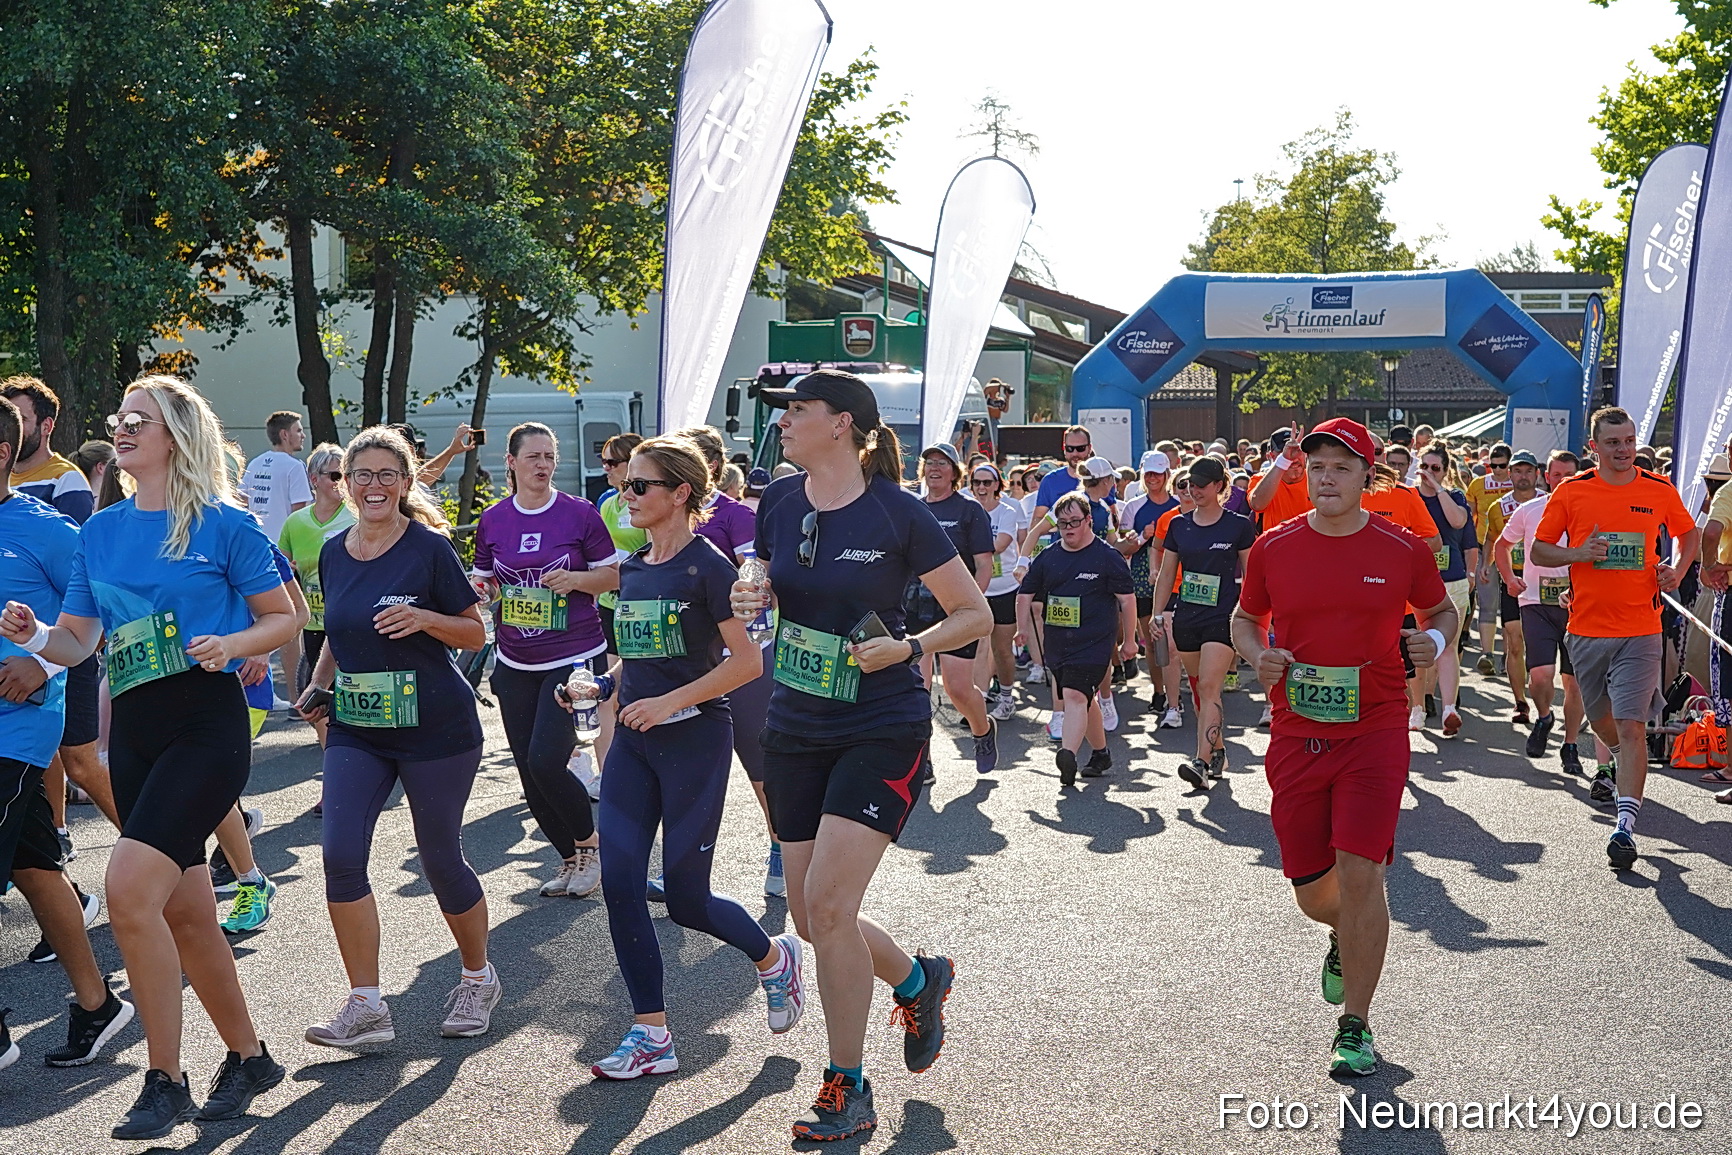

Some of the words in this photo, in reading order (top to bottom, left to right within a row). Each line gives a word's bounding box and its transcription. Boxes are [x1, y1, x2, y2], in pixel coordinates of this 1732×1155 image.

[1657, 170, 1702, 274] Fischer
[1320, 294, 1350, 302] Fischer
[1297, 309, 1386, 326] firmenlauf
[1126, 338, 1174, 350] Fischer
[1630, 506, 1653, 515] THULE
[1363, 576, 1385, 584] Florian
[1189, 583, 1209, 595] 916
[509, 599, 542, 615] 1554
[1052, 606, 1070, 617] 866
[619, 620, 652, 640] 1164
[652, 623, 662, 650] 2022
[634, 641, 651, 650] Peggy
[111, 642, 146, 675] 1813
[146, 641, 159, 671] 2022
[784, 644, 823, 674] 1163
[125, 663, 150, 678] Caroline
[800, 672, 821, 684] Nicole
[821, 659, 833, 688] 2022
[340, 690, 382, 710] 1162
[1289, 687, 1297, 706] RUN
[1297, 683, 1346, 704] 1233
[357, 710, 381, 719] Brigitte
[383, 694, 392, 720] 2022
